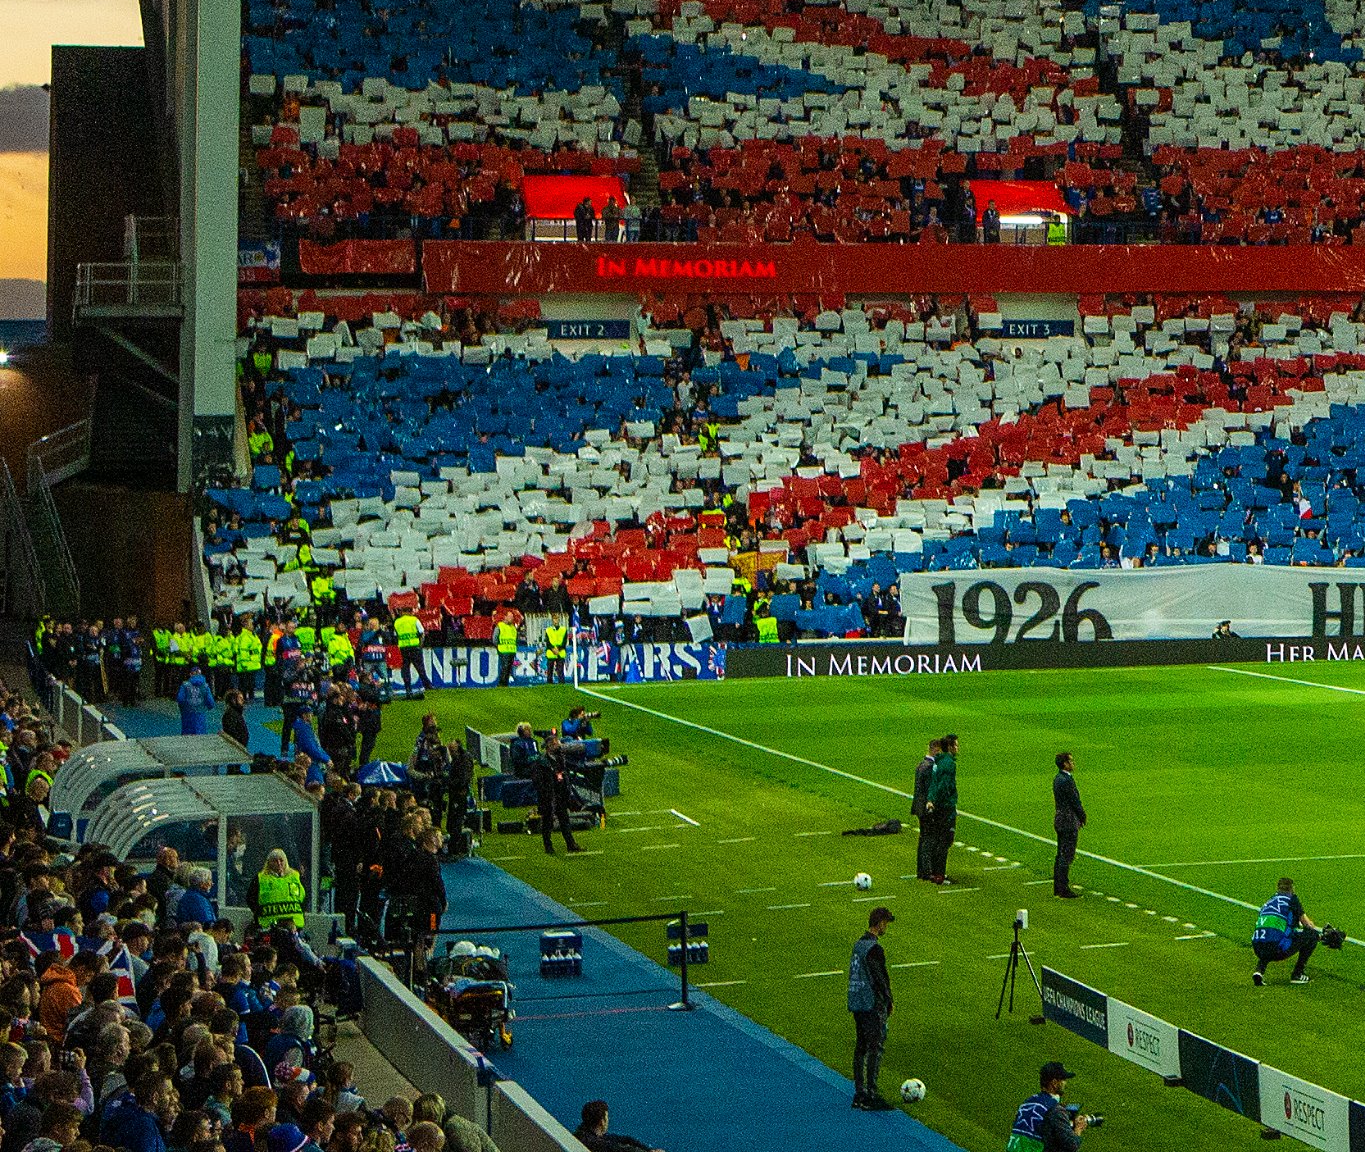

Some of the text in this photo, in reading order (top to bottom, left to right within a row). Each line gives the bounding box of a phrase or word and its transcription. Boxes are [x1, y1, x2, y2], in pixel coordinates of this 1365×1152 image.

[597, 256, 778, 279] IN MEMORIAM
[561, 324, 605, 336] EXIT 2
[1009, 323, 1051, 336] EXIT 3
[932, 581, 1111, 645] 1926
[786, 652, 982, 677] IN MEMORIAM
[1265, 643, 1316, 663] HER
[262, 902, 303, 915] STEWAR
[1043, 986, 1106, 1031] UEFA CHAMPIONS LEAGUE
[1135, 1028, 1161, 1057] RESPECT
[1293, 1098, 1325, 1132] RESPECT
